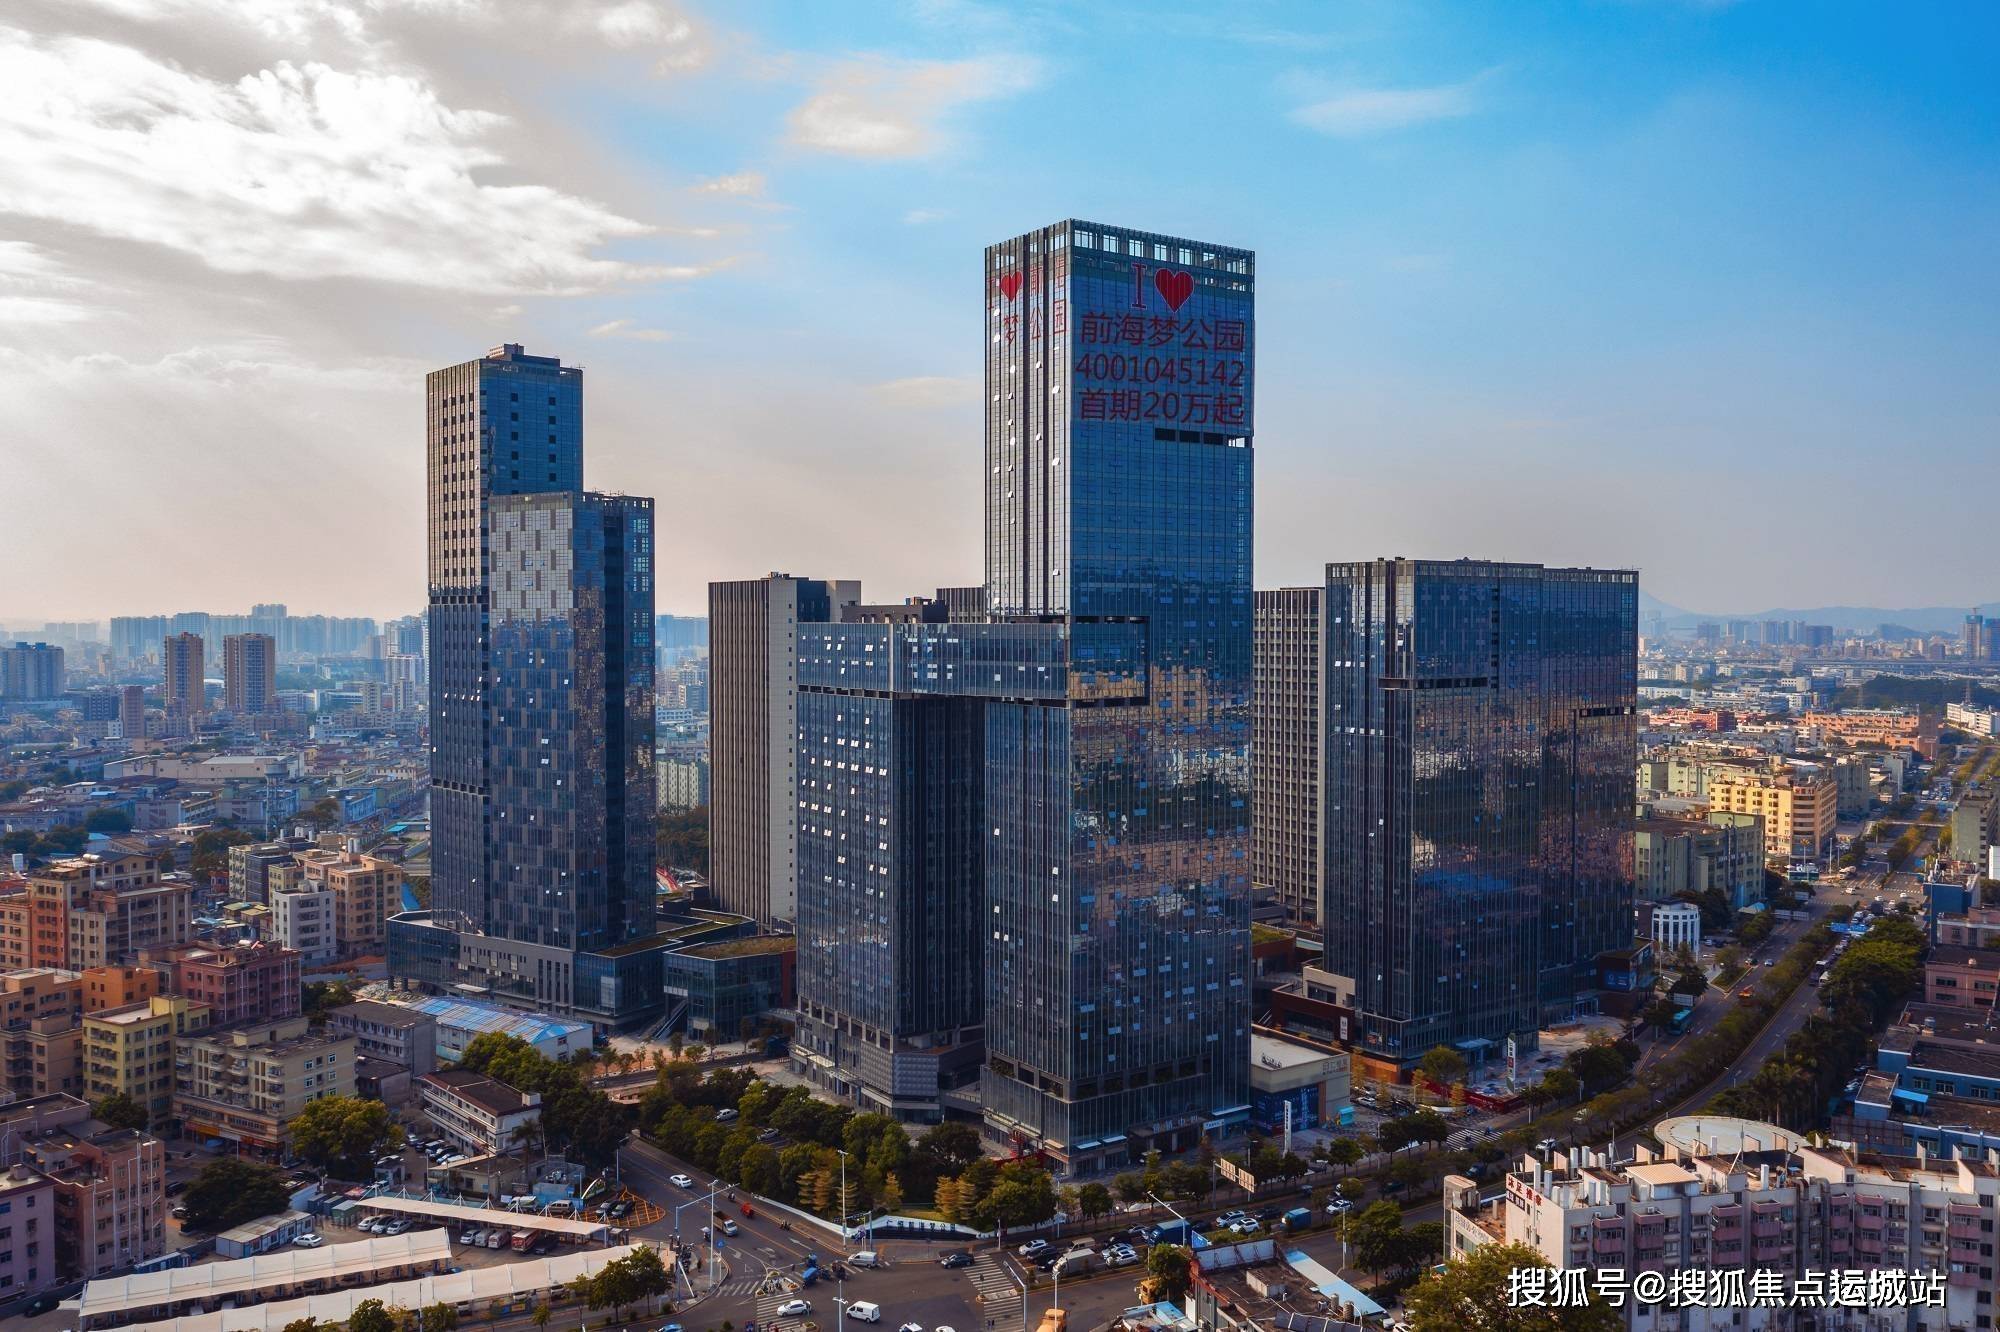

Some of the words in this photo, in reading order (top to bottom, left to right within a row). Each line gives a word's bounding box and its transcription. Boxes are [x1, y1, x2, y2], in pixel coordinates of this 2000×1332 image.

[1131, 263, 1147, 310] I
[1080, 311, 1245, 351] 前海梦公园
[1075, 353, 1244, 387] 4001045142
[1079, 388, 1244, 425] 首期20万起
